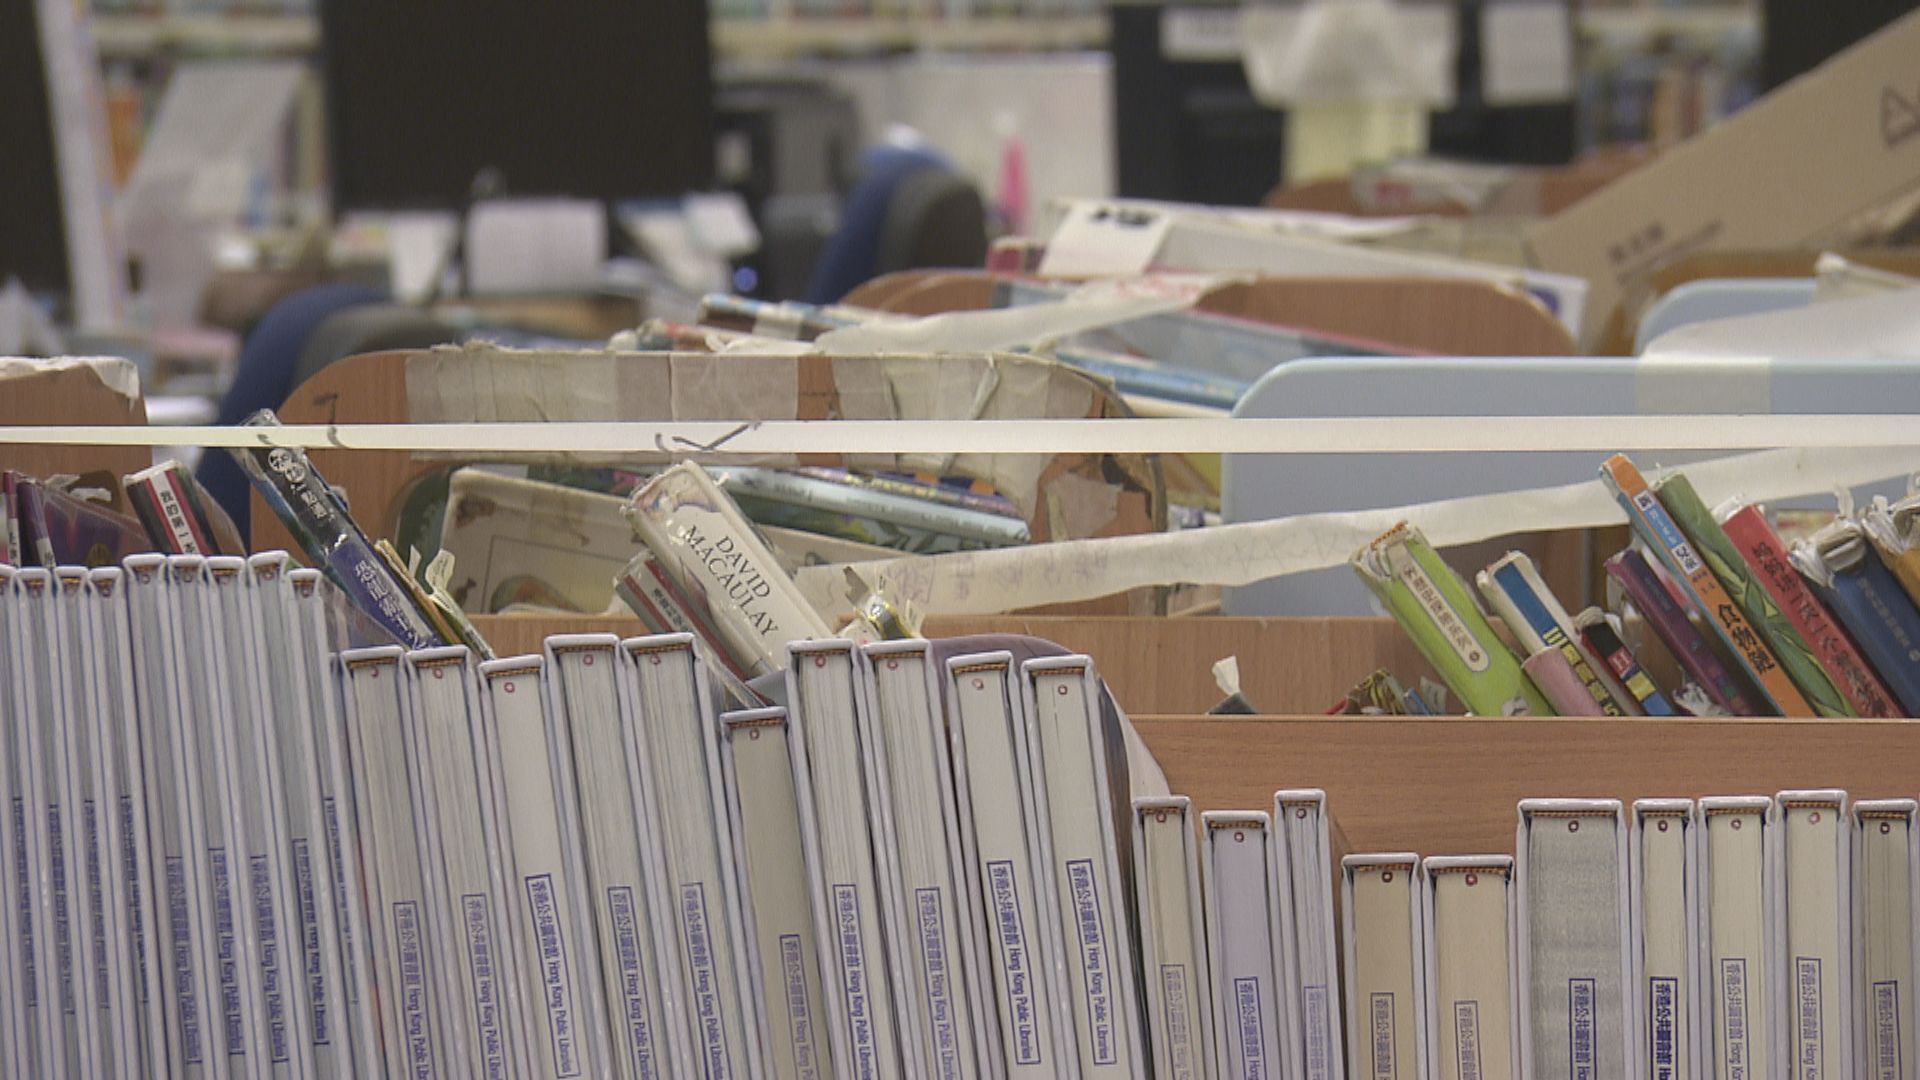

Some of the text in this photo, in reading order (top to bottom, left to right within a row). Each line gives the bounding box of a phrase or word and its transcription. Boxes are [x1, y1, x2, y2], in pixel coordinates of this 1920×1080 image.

[715, 535, 771, 599] DAVID
[682, 525, 780, 637] MACAULAY
[1006, 947, 1023, 971] Hong
[1085, 946, 1101, 970] Hong
[545, 960, 560, 984] Hong
[694, 969, 711, 993] Hong
[1009, 972, 1027, 996] Kong
[1087, 971, 1105, 995] Kong
[548, 984, 564, 1008] Kong
[627, 996, 643, 1019] Kong
[699, 993, 715, 1016] Kong
[849, 994, 866, 1017] Kong
[1015, 997, 1030, 1023] Public
[1093, 996, 1108, 1022] Public
[554, 1008, 568, 1035] Public
[704, 1017, 719, 1043] Public
